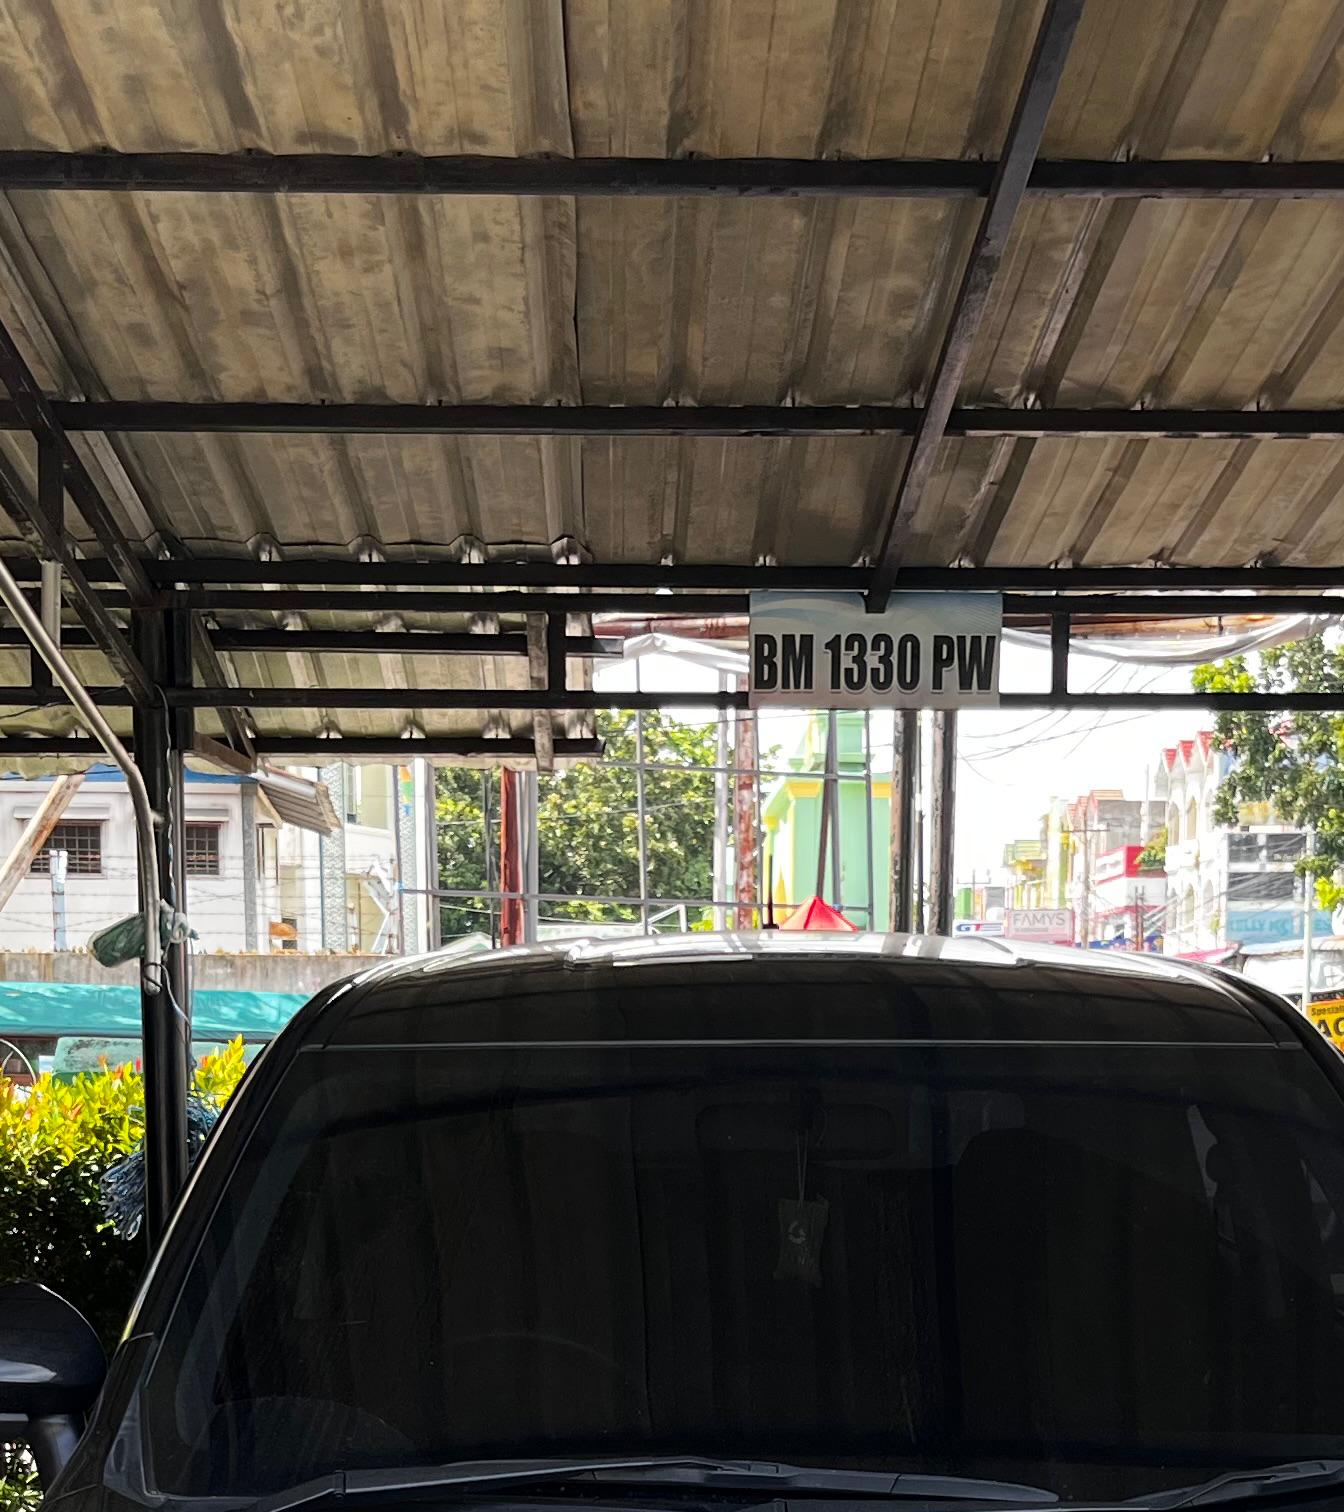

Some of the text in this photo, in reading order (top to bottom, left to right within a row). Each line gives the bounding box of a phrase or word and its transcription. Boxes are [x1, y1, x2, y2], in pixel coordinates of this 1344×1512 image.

[753, 633, 996, 691] BM 1330 PW
